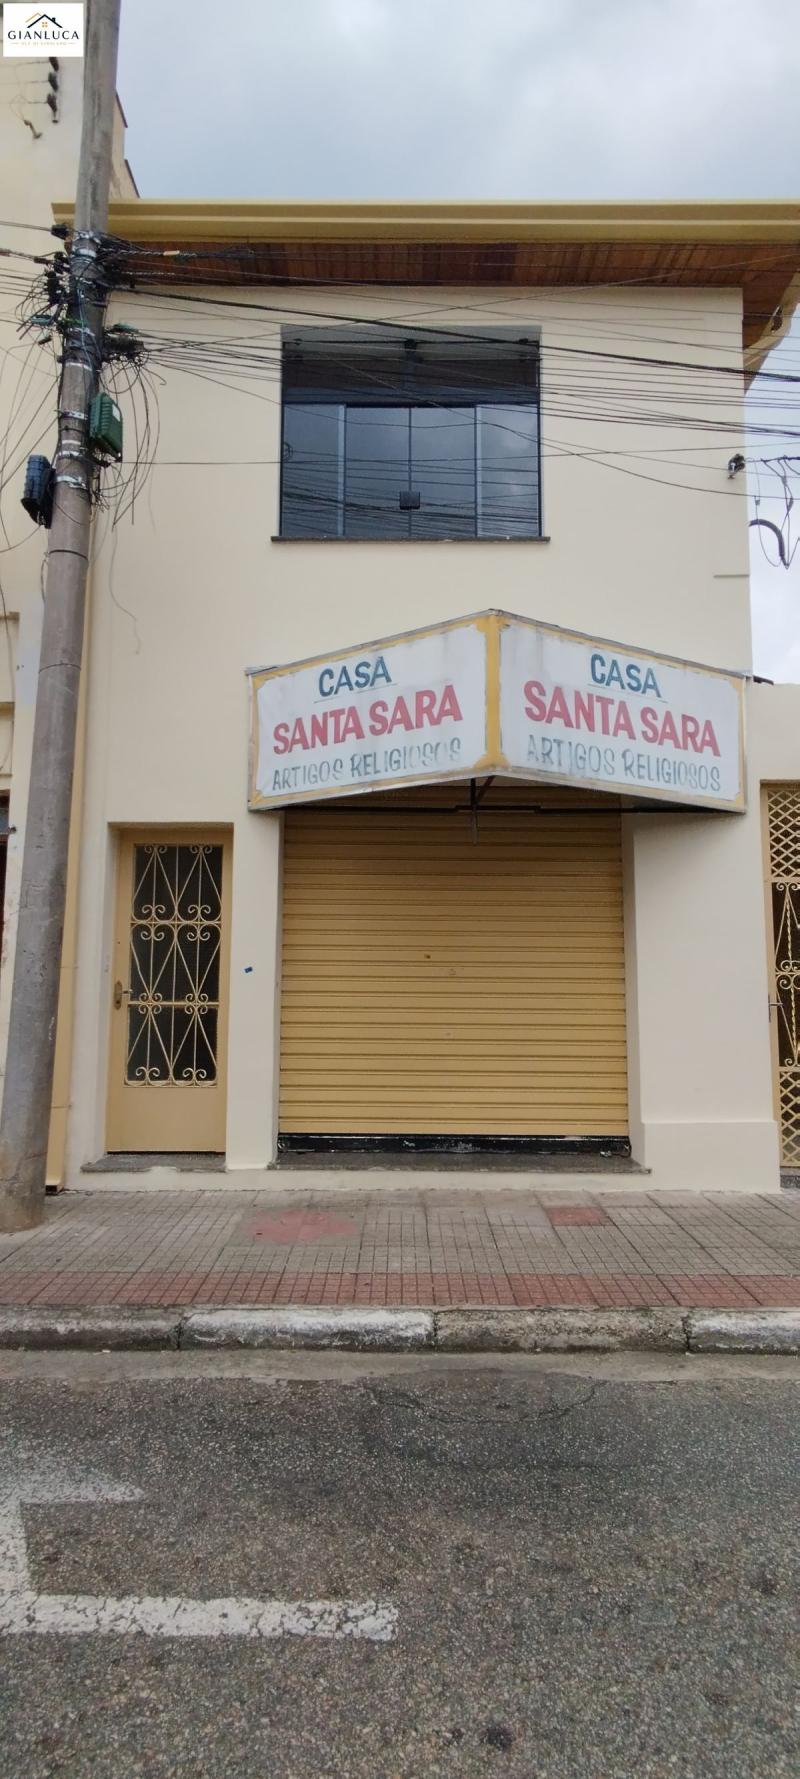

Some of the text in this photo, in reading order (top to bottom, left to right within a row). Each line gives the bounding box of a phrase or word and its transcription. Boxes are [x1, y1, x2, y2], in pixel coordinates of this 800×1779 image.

[318, 656, 393, 697] CASA
[590, 653, 662, 699] CASA
[273, 684, 464, 755] SANTA SARA
[523, 680, 722, 757] SANTA SARA
[272, 758, 344, 791] ARTIGOS
[527, 734, 722, 792] ARTIGOS RELIGIOSOS
